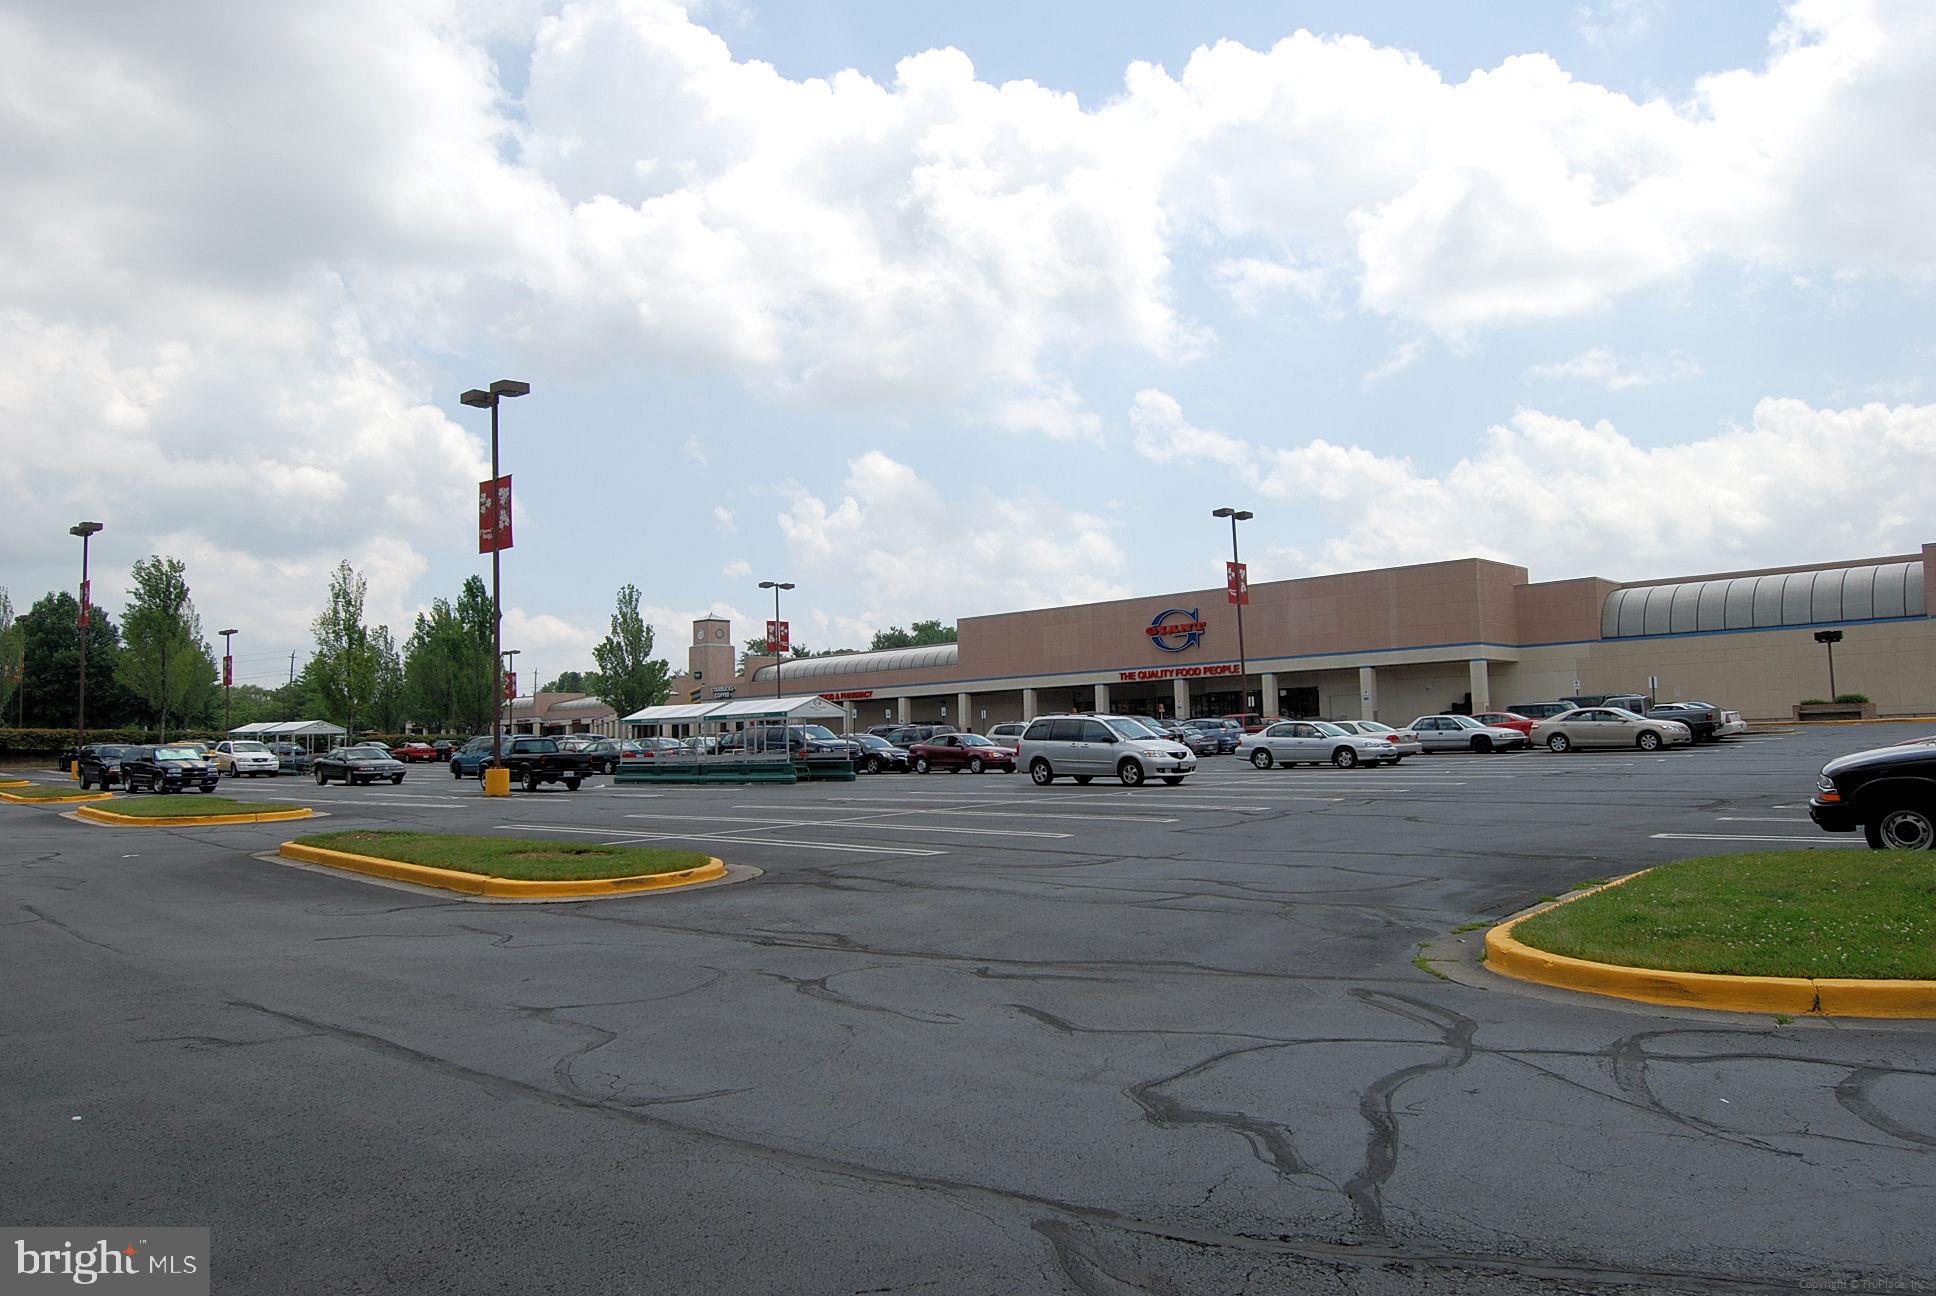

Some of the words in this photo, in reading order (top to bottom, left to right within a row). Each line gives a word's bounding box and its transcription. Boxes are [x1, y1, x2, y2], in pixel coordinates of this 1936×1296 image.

[1145, 621, 1207, 637] GIANT
[1119, 671, 1136, 681] THE
[1138, 668, 1174, 680] QUALITY
[1175, 666, 1202, 677] FOOD
[1203, 664, 1240, 675] PEOPLE
